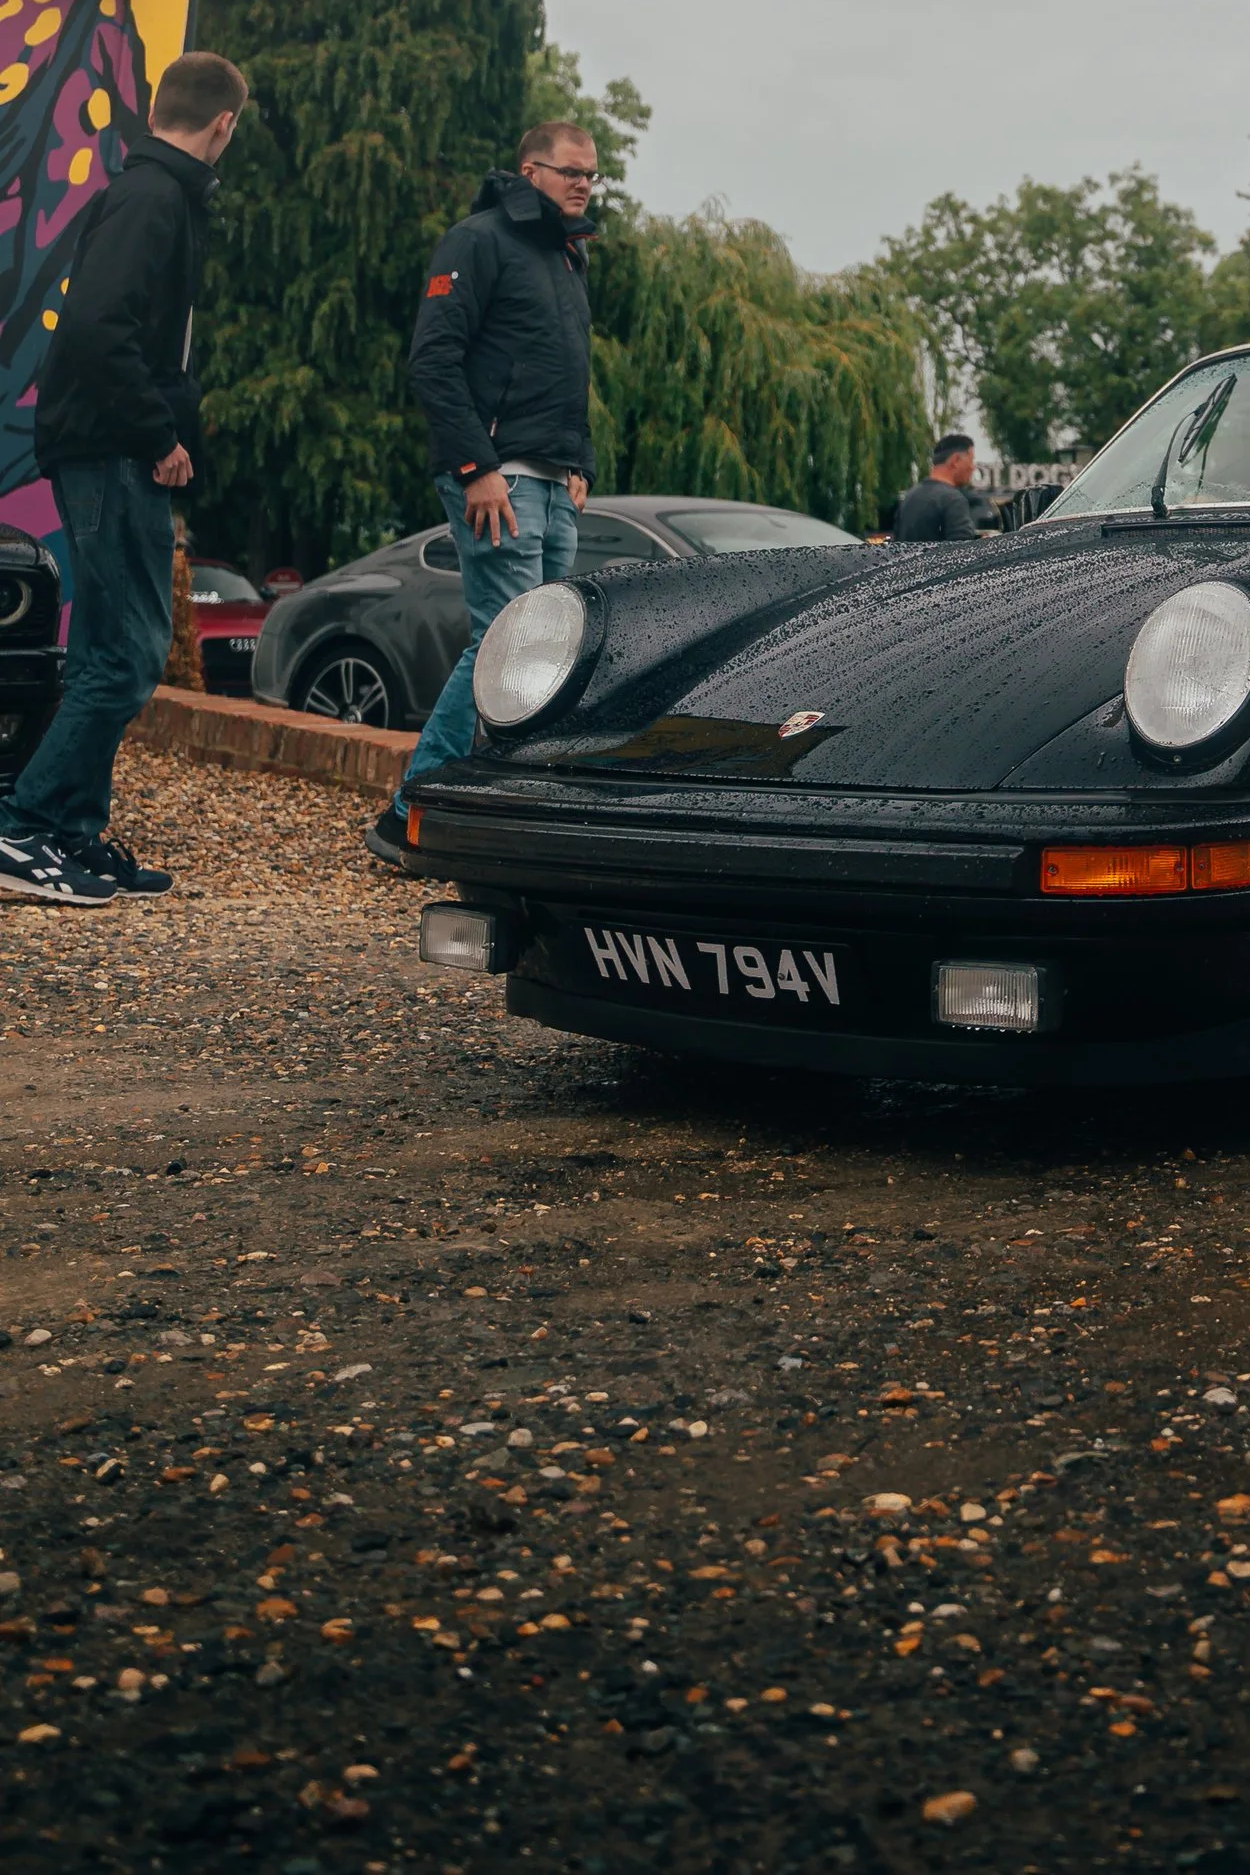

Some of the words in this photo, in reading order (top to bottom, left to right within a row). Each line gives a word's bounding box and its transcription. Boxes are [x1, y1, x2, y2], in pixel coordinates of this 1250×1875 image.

[971, 462, 1003, 488] OT
[584, 927, 691, 990] HVN
[696, 941, 840, 1005] 794V
